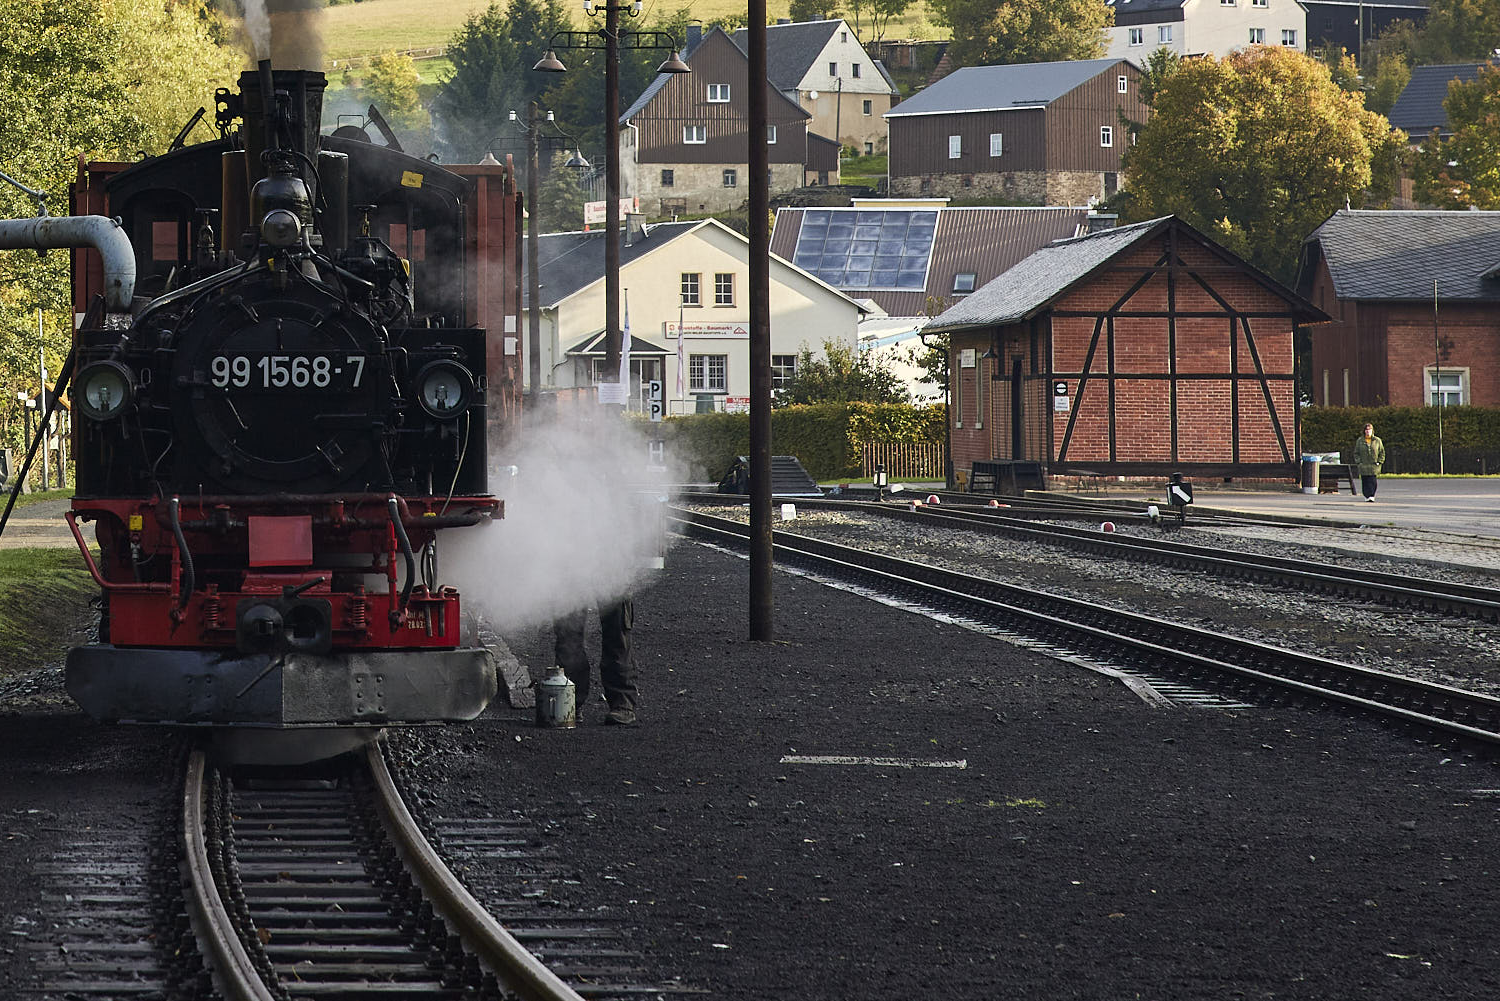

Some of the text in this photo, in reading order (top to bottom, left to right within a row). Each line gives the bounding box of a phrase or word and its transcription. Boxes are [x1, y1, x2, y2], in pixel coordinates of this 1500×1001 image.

[211, 356, 250, 388] 99
[651, 382, 660, 398] P
[651, 404, 660, 420] P
